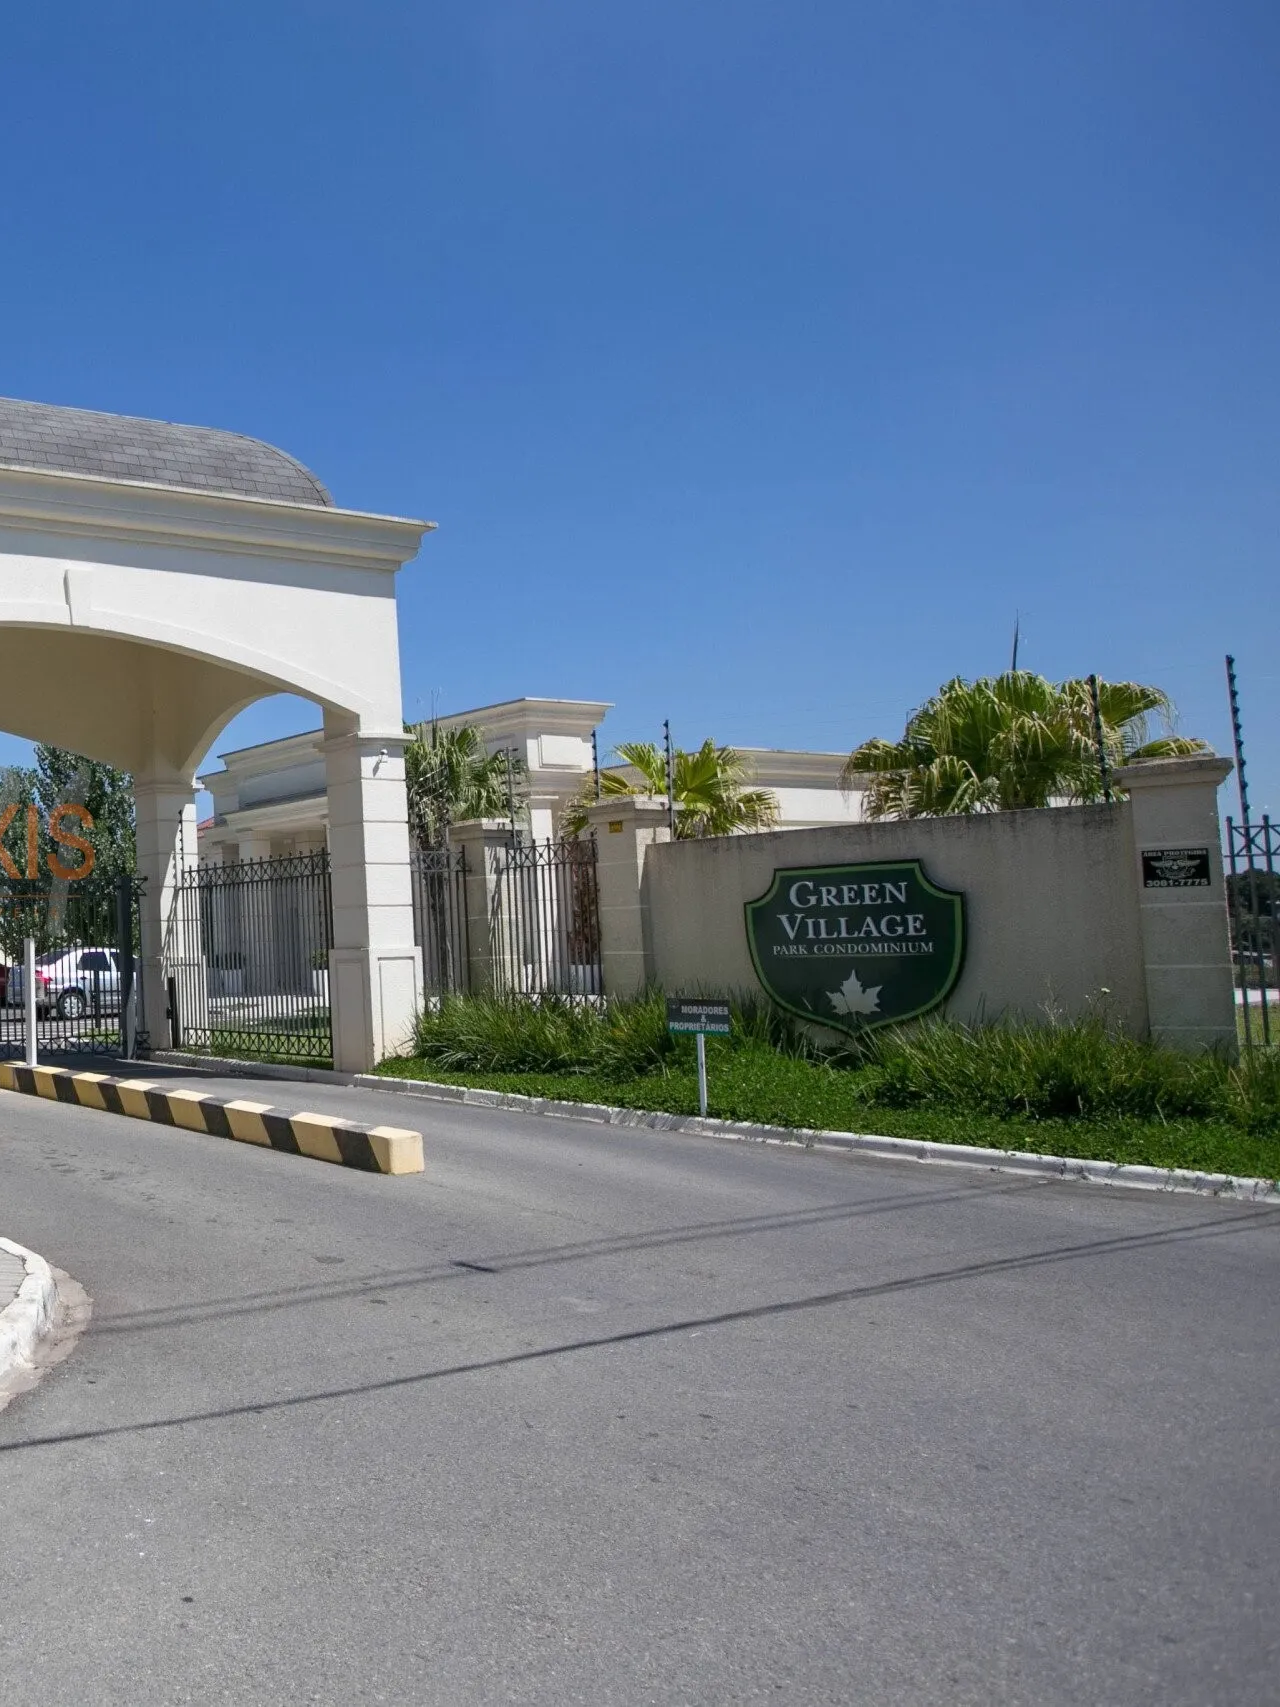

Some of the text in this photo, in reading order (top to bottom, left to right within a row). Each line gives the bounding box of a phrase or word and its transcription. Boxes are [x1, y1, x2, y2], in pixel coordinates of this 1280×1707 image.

[789, 881, 908, 908] GREEN
[776, 913, 927, 940] VILLAGE
[773, 942, 934, 956] PARK CONDOMINIUM
[681, 1005, 729, 1015] MORADORES
[669, 1021, 729, 1032] PROPRIETÁRIOS
